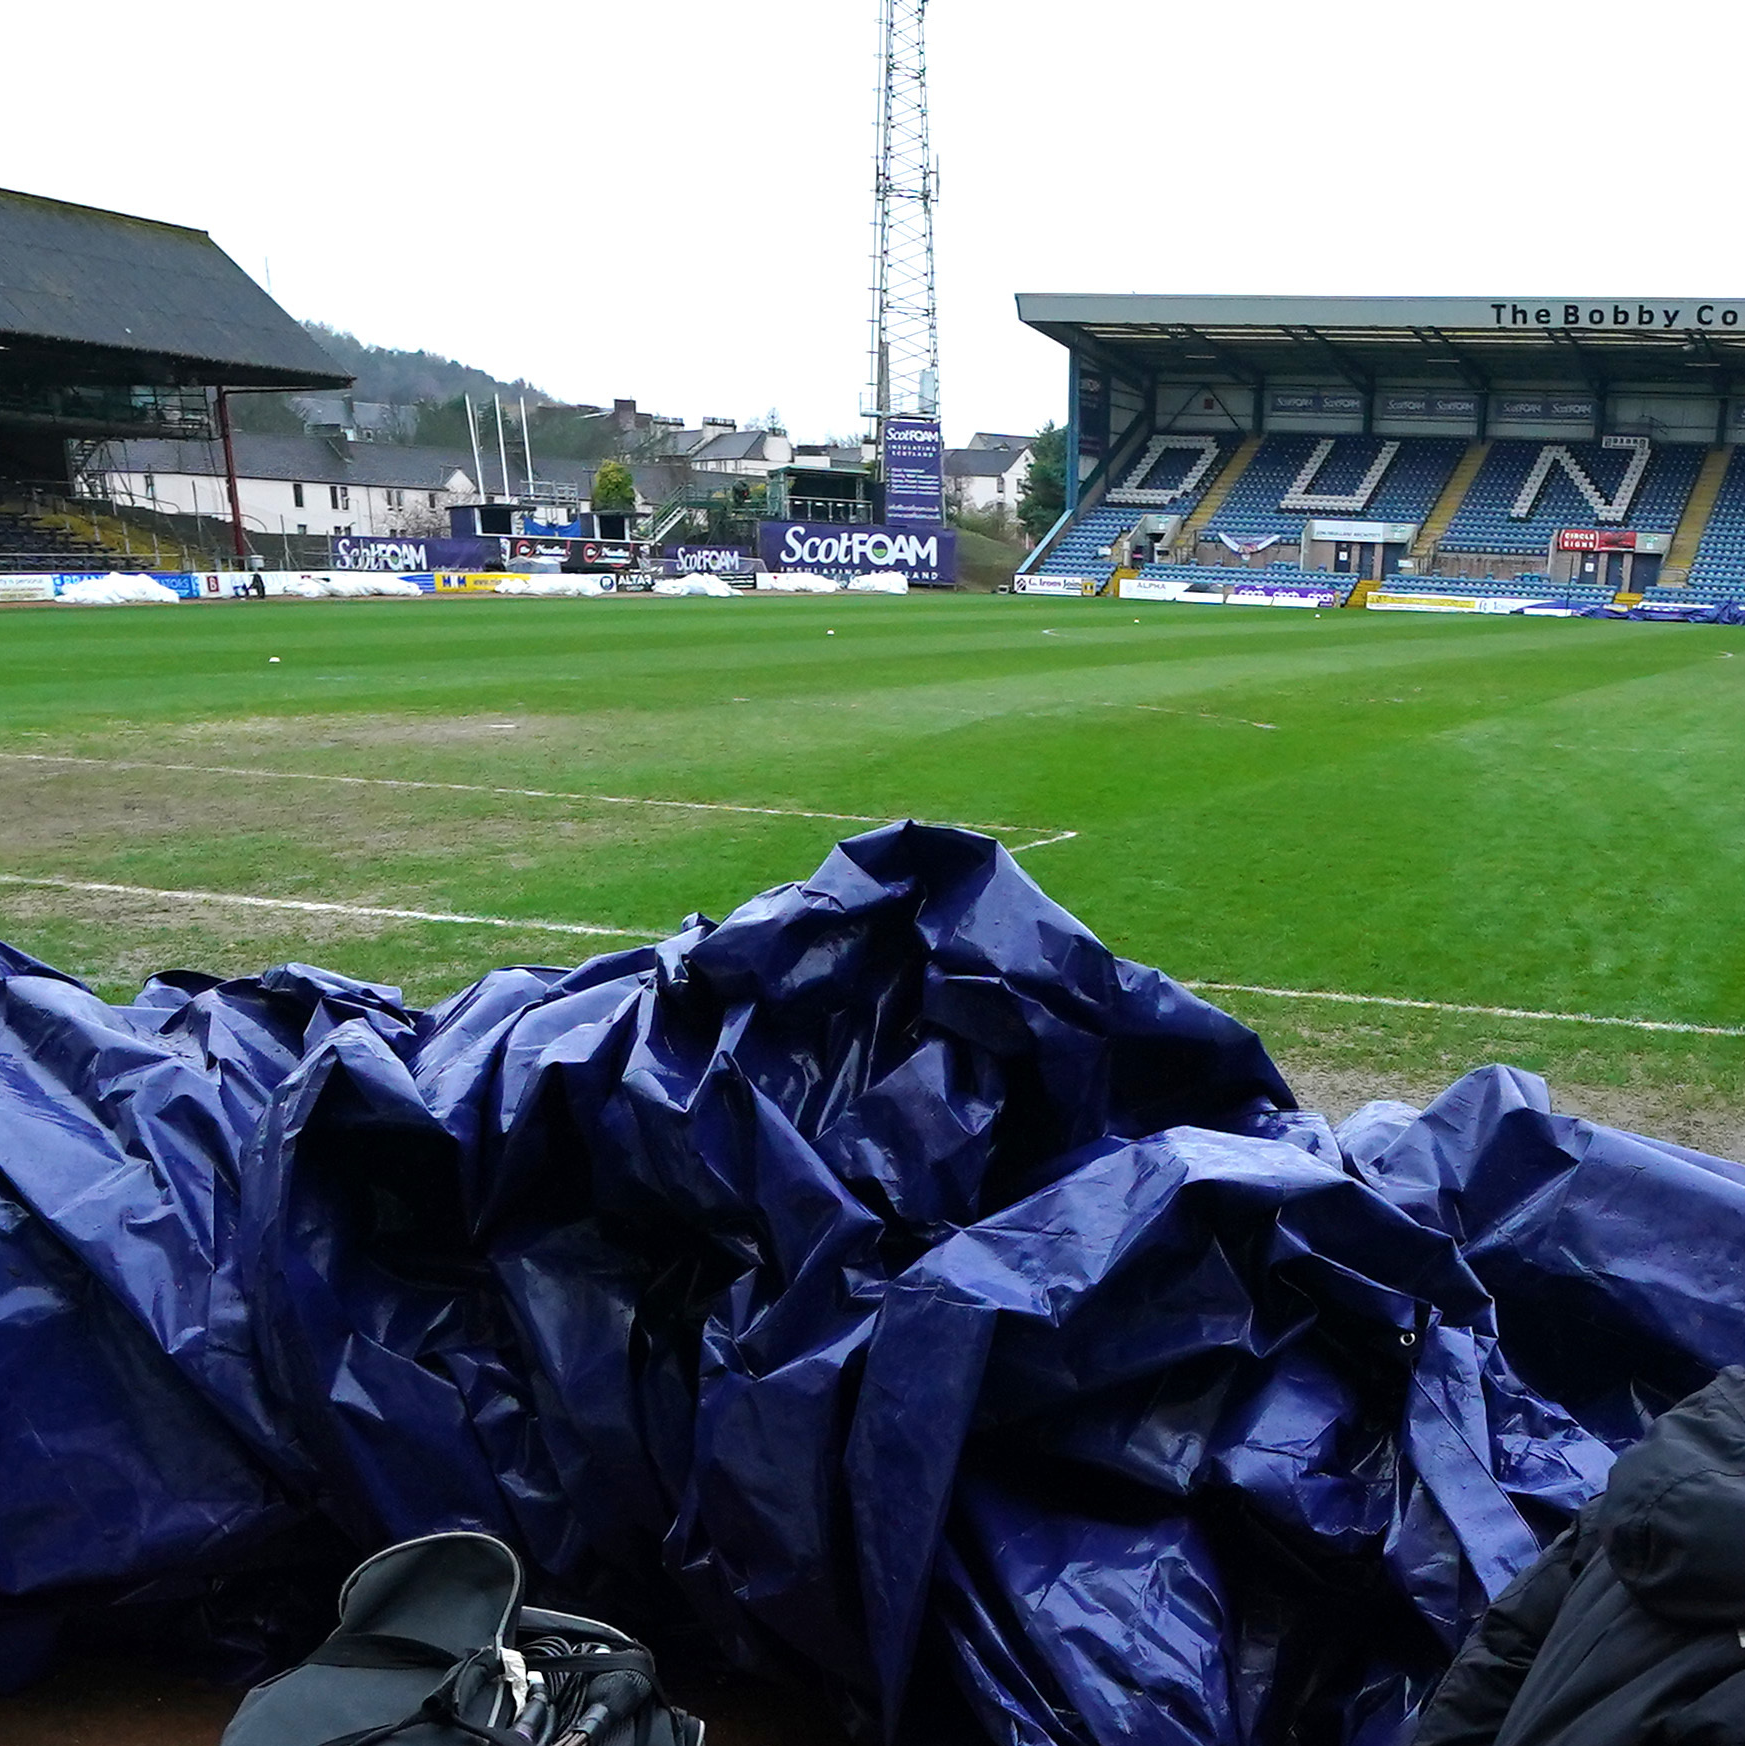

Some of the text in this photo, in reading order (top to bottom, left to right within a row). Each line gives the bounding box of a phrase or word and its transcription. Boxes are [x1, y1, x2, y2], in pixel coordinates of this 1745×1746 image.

[1491, 303, 1552, 326] The
[1564, 304, 1681, 329] Bobby
[886, 427, 939, 442] ScotFOAM
[1563, 540, 1594, 548] SIGNS
[1564, 532, 1595, 540] CIRCLE
[336, 538, 428, 571] ScotFOAM
[780, 526, 938, 569] ScotFOAM
[676, 547, 740, 572] ScotFOAM
[442, 575, 467, 588] MKM
